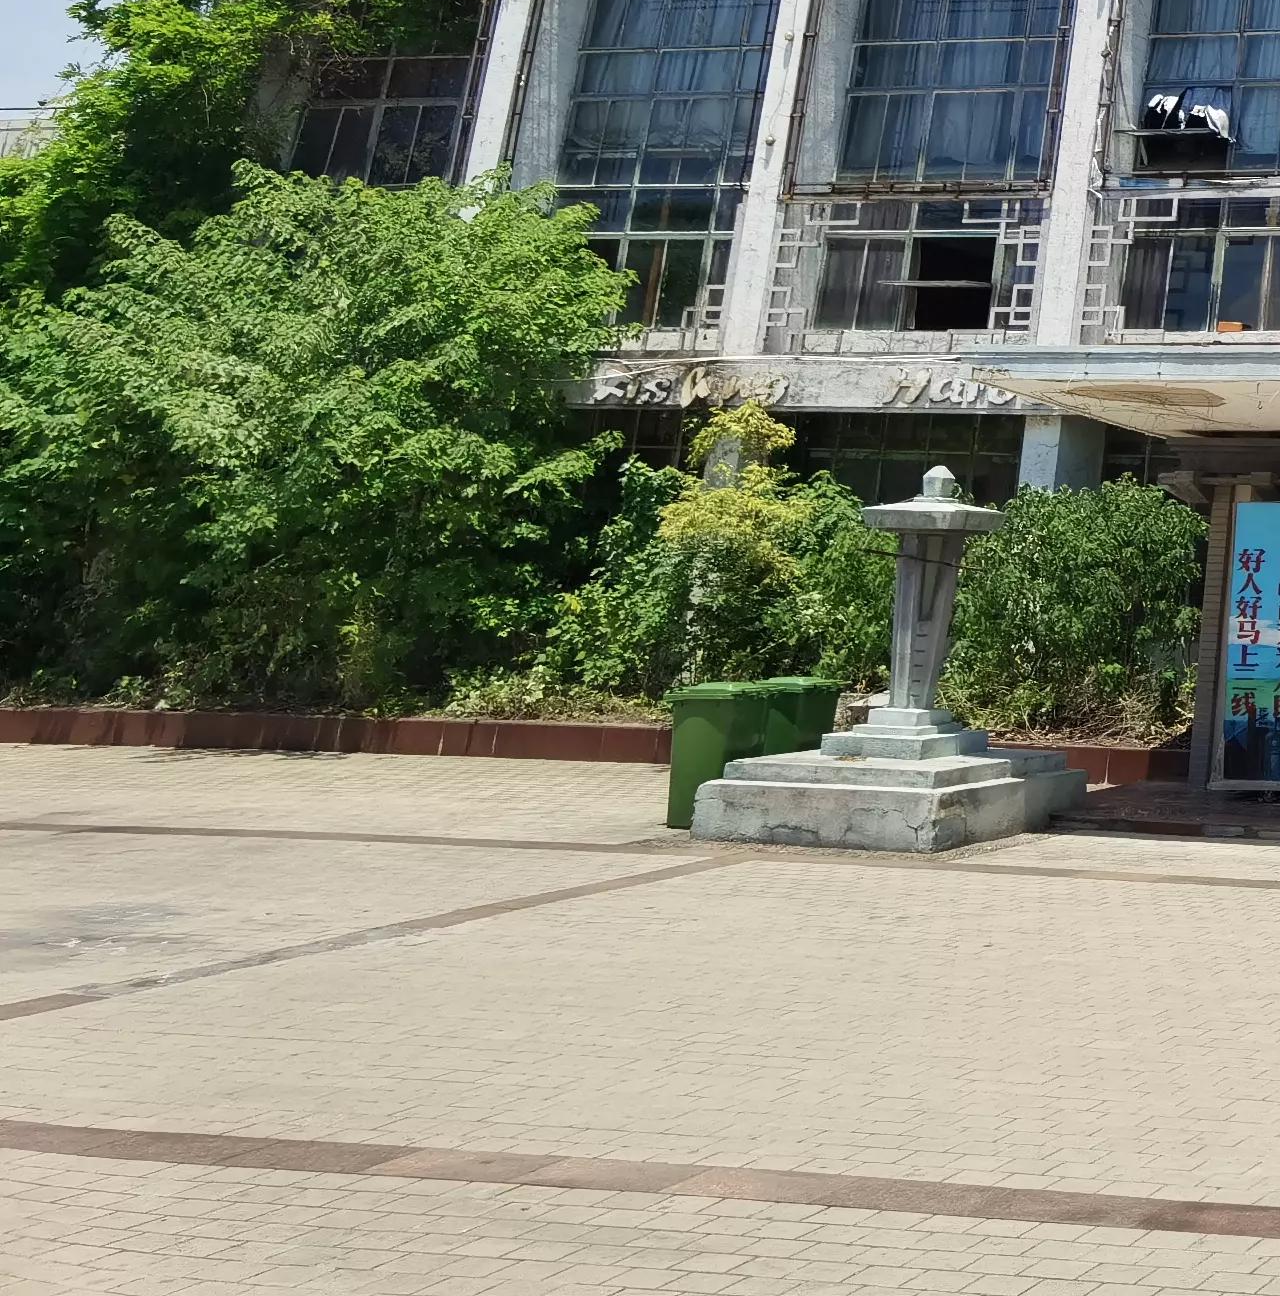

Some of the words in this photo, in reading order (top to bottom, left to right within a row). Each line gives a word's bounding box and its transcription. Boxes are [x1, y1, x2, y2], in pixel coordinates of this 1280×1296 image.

[1231, 548, 1266, 717] 好人好马上三线
